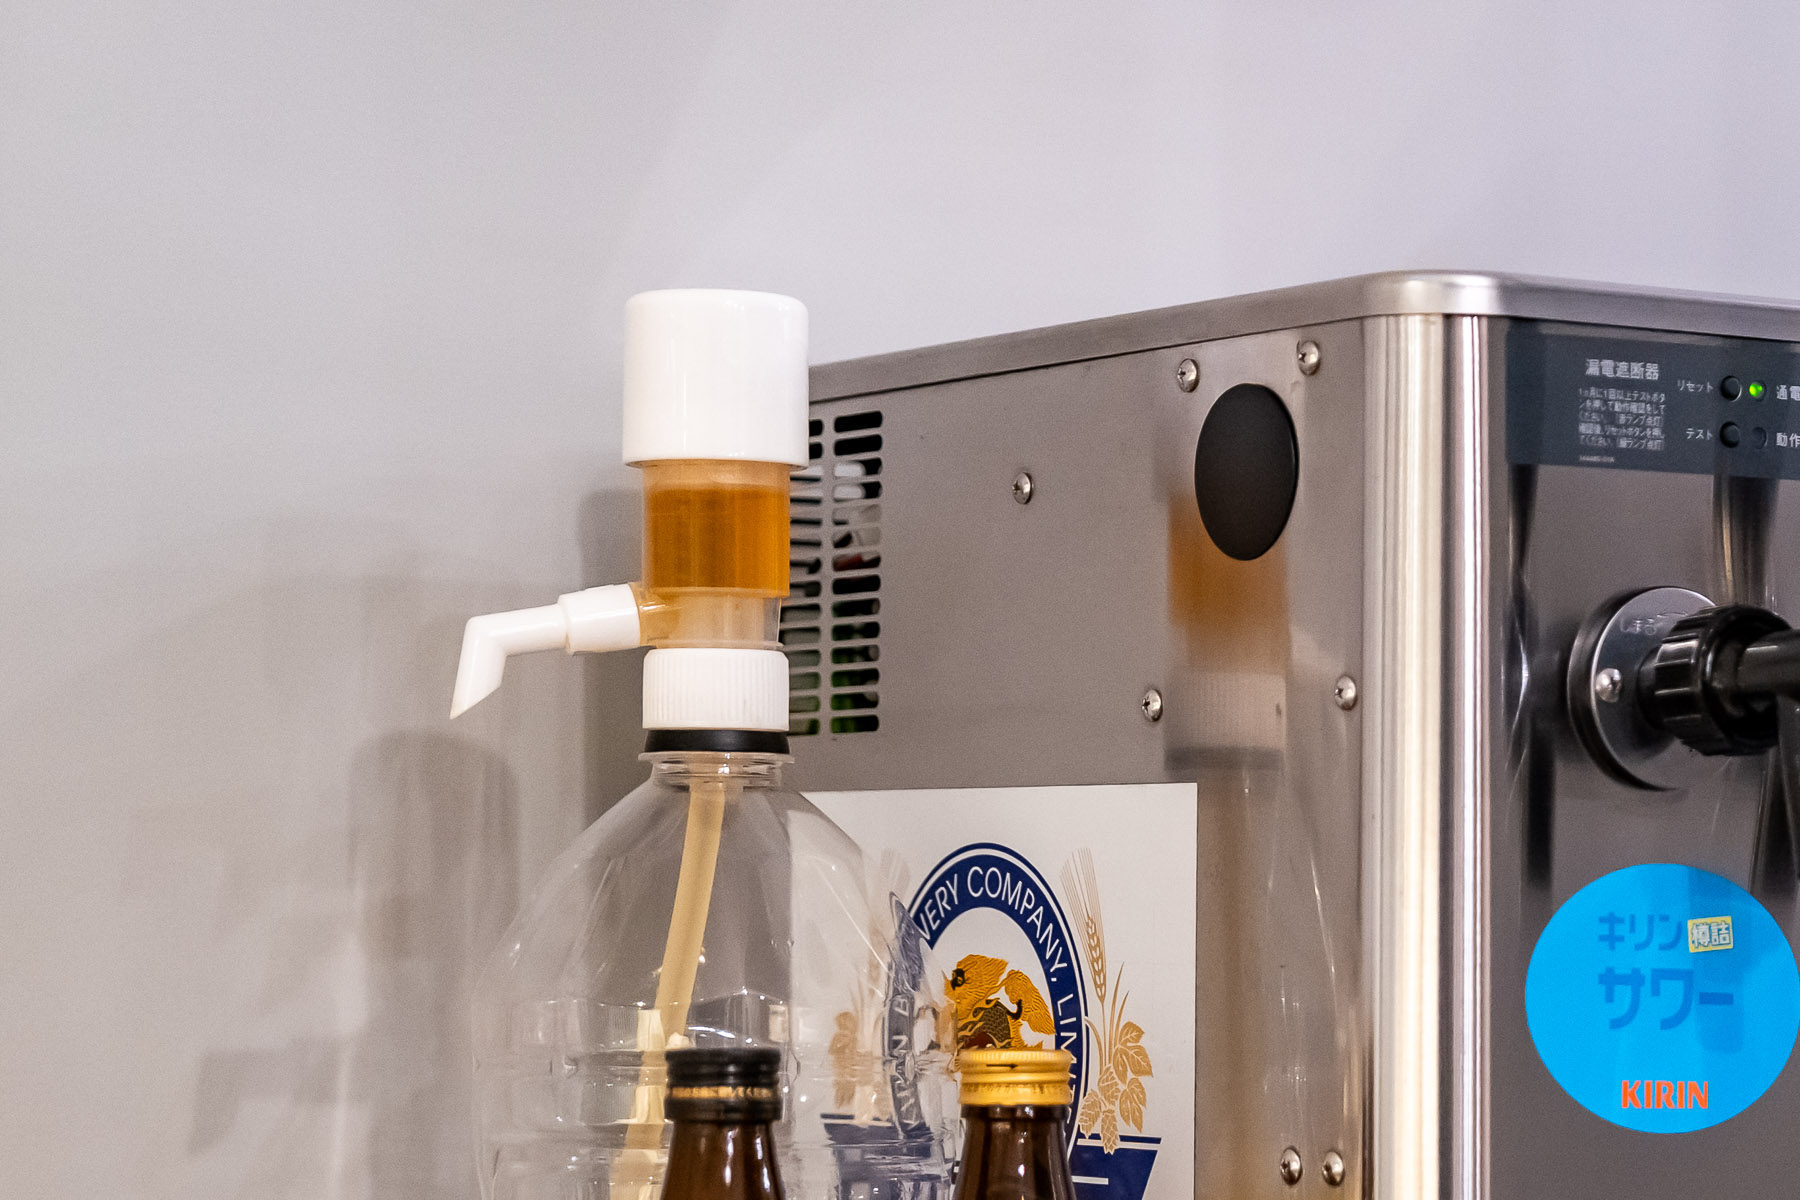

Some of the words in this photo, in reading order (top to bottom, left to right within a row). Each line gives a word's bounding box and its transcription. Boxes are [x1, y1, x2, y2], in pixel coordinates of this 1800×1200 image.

[1585, 358, 1659, 380] 漏電遮断器
[1677, 379, 1714, 393] リセット
[1685, 427, 1714, 440] テスト
[967, 866, 1067, 983] COMPANY,
[1598, 911, 1683, 951] キリン
[1691, 921, 1731, 949] 樽詰
[1597, 967, 1735, 1031] サワー
[1621, 1080, 1709, 1109] KIRIN
